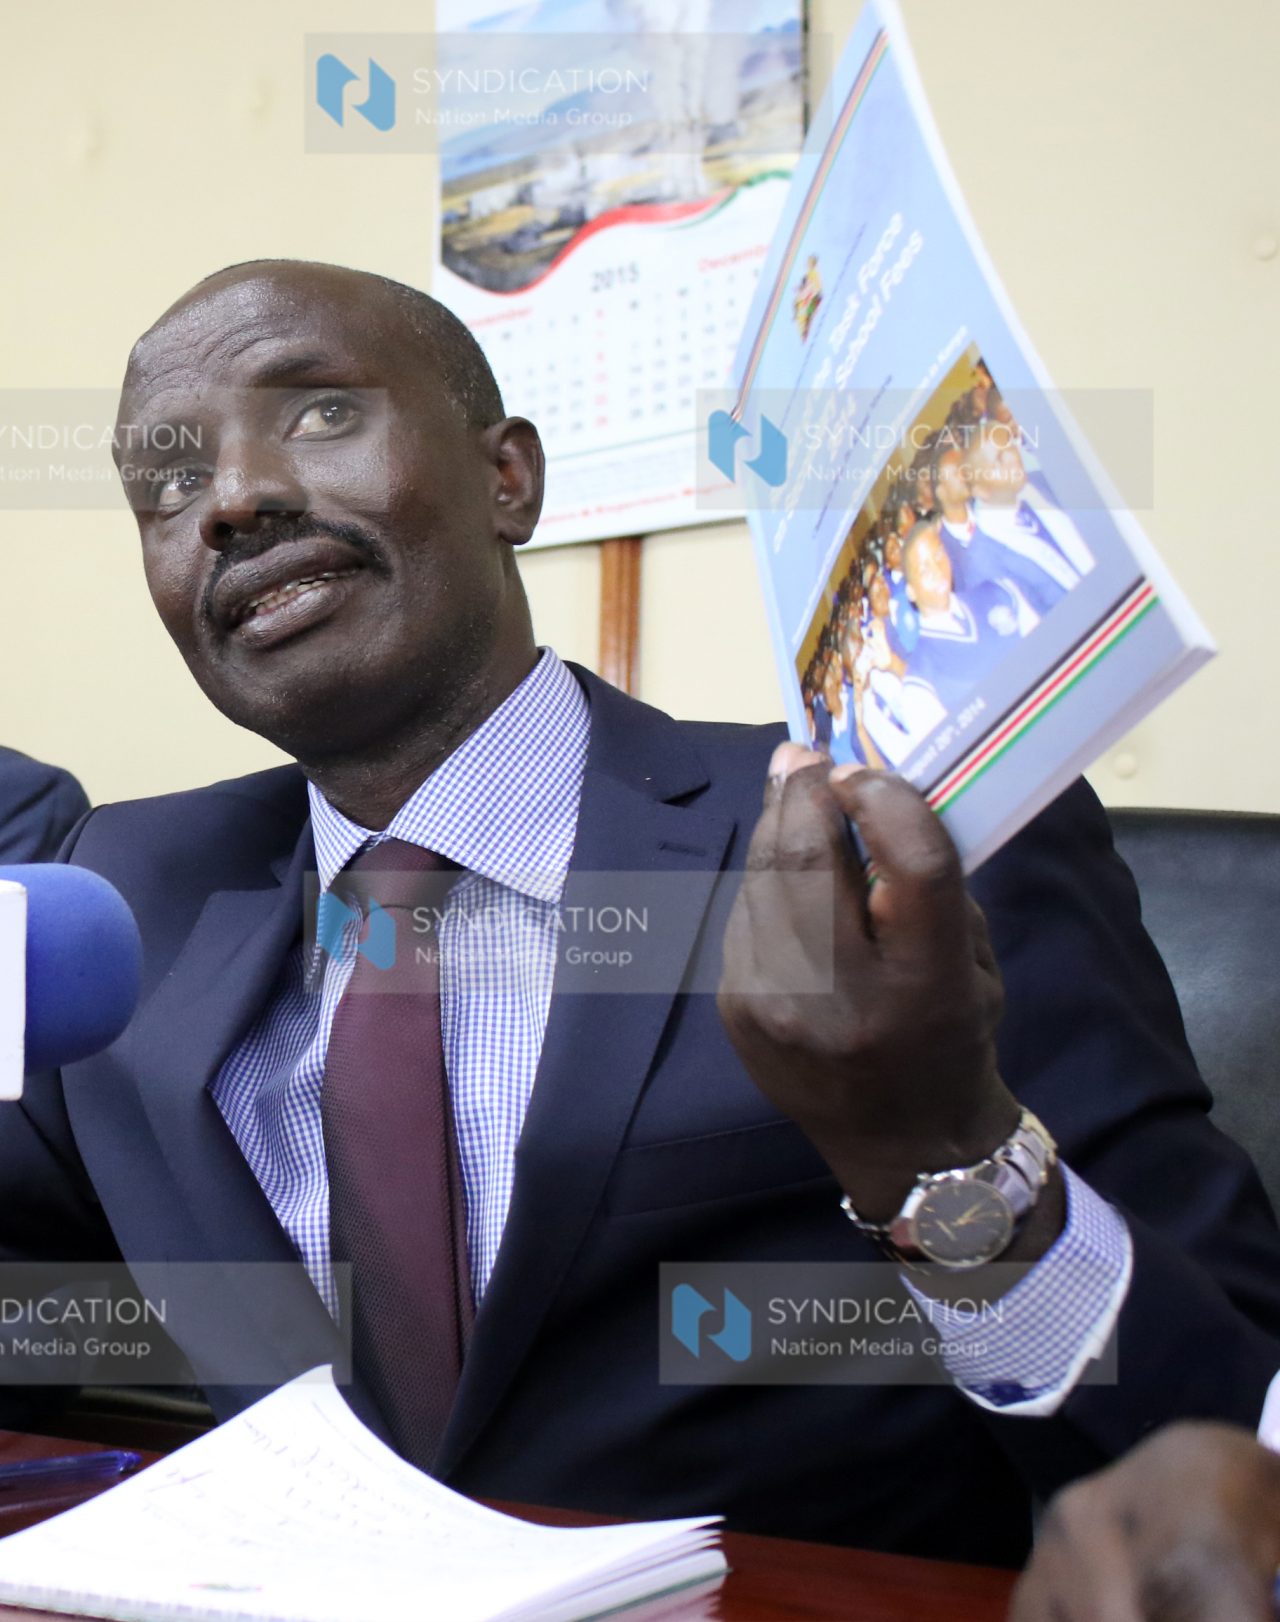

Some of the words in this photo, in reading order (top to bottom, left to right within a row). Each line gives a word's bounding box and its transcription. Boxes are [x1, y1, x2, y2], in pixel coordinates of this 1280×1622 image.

[590, 261, 641, 293] 2015
[856, 211, 904, 296] Force
[835, 293, 882, 393] School
[880, 228, 924, 303] Fees
